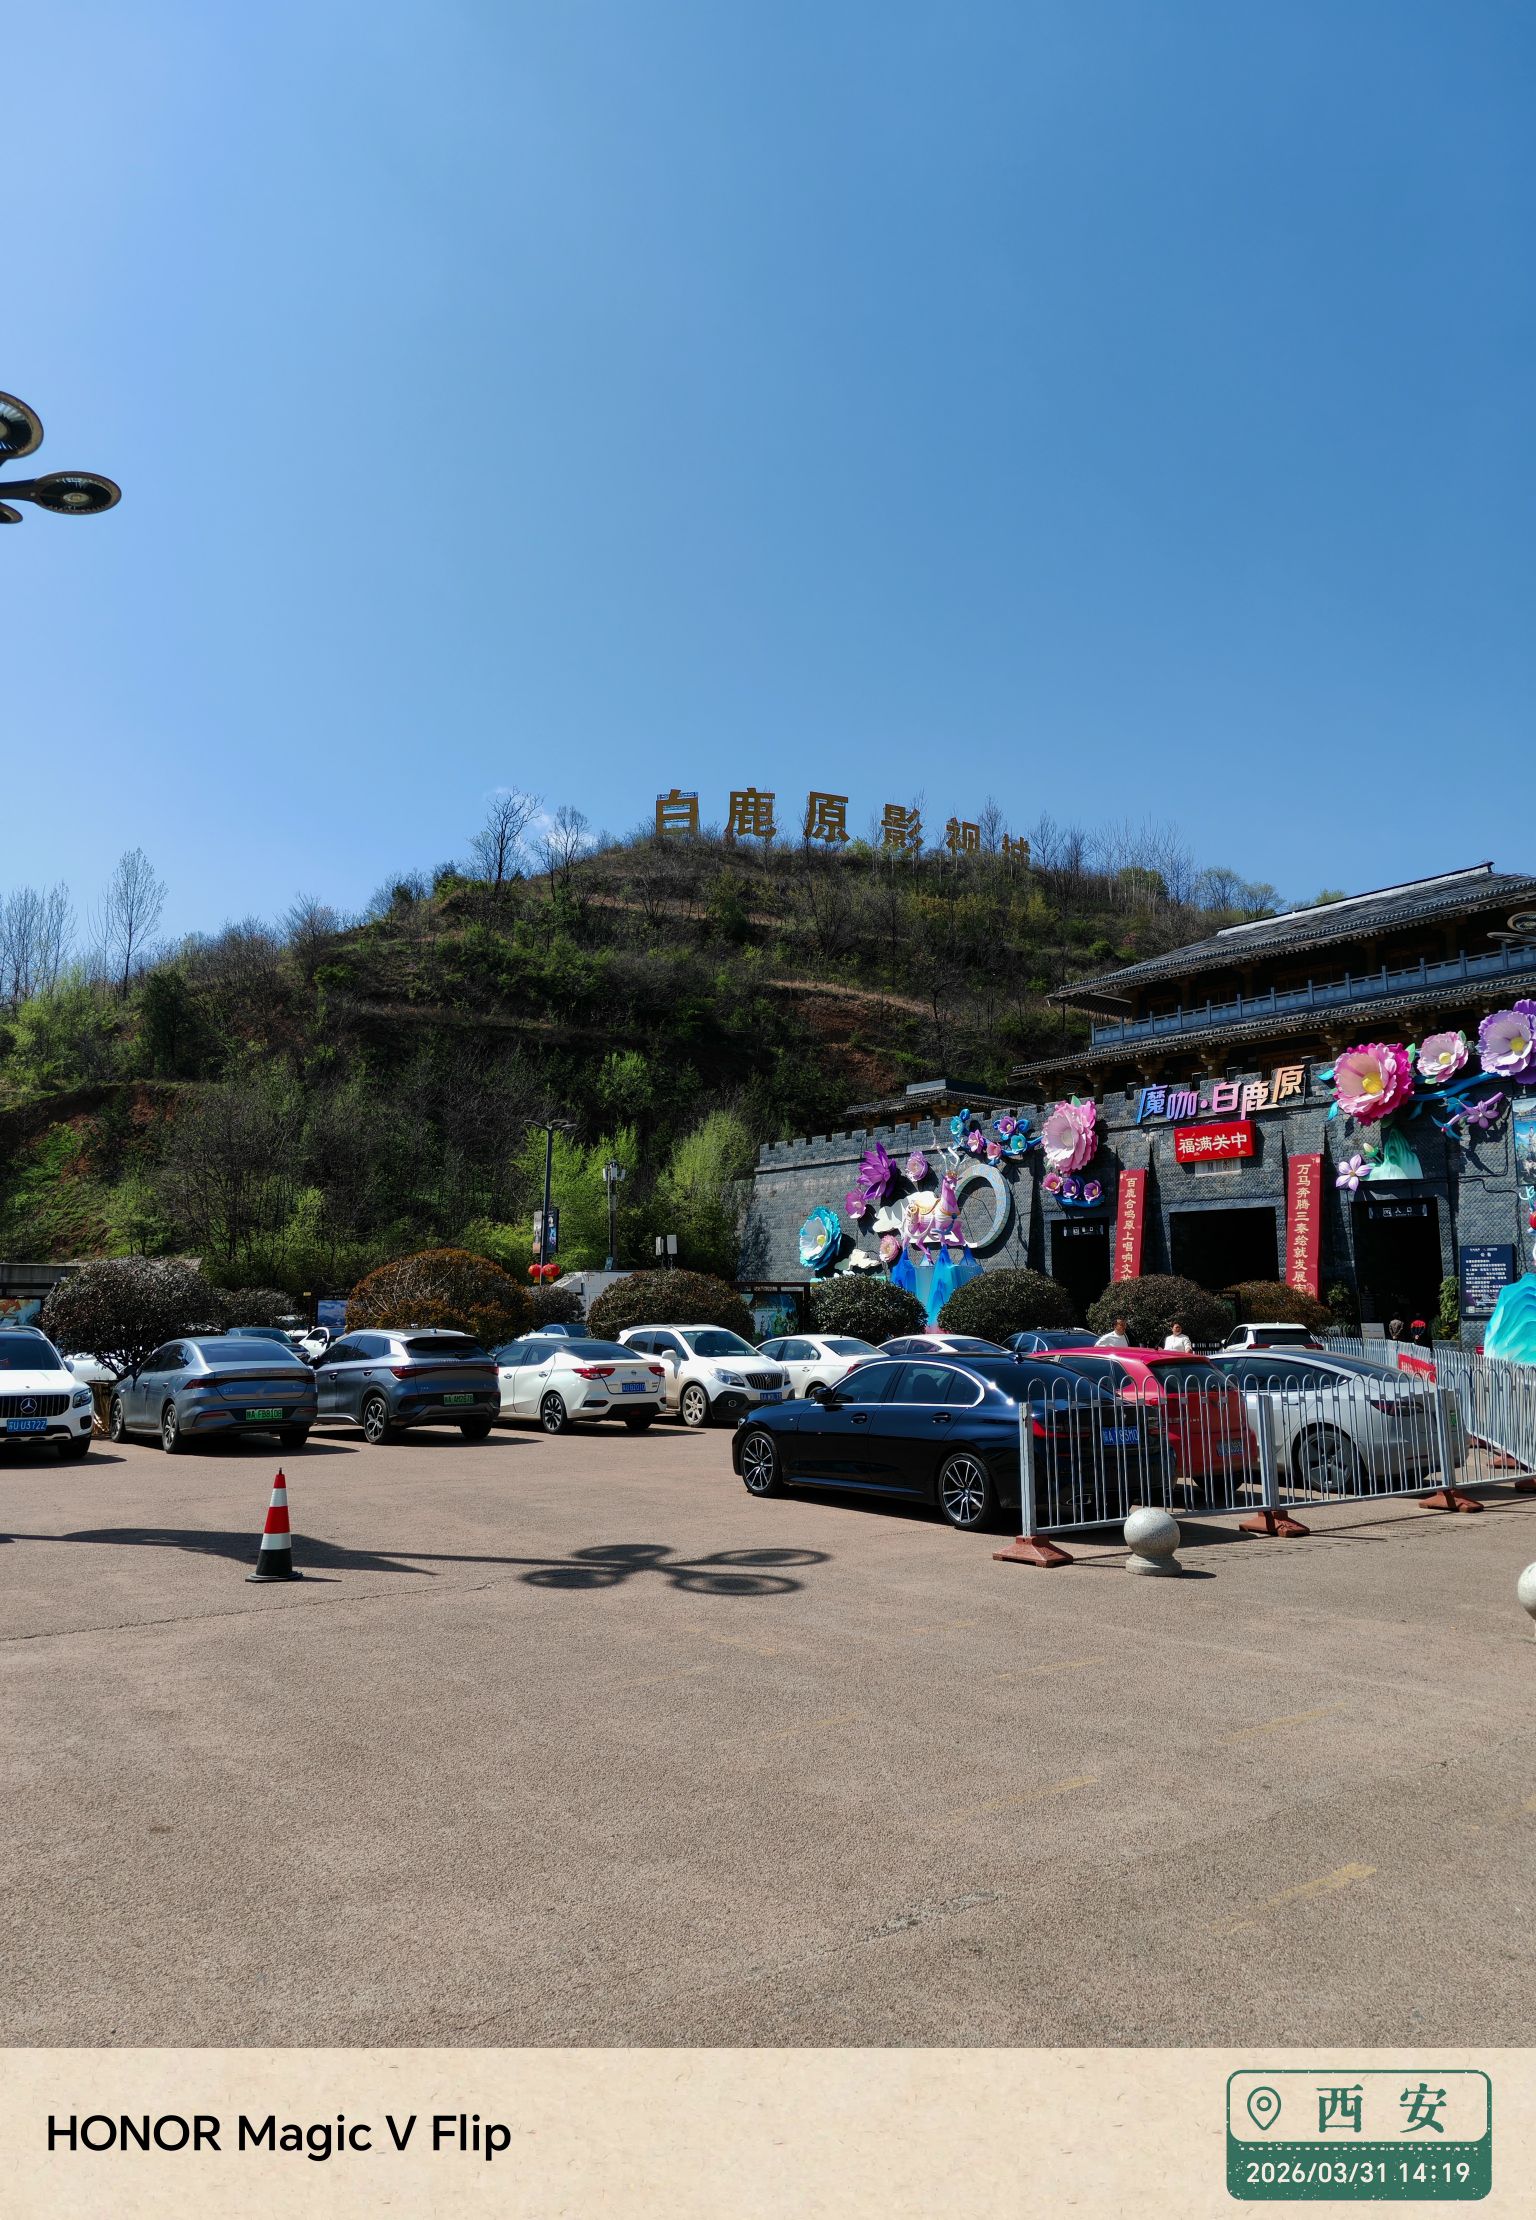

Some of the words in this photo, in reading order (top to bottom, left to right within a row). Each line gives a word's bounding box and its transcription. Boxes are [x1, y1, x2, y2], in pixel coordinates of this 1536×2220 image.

[1136, 1065, 1306, 1124] 魔咖·白鹿原
[1178, 1132, 1247, 1154] 福满关中
